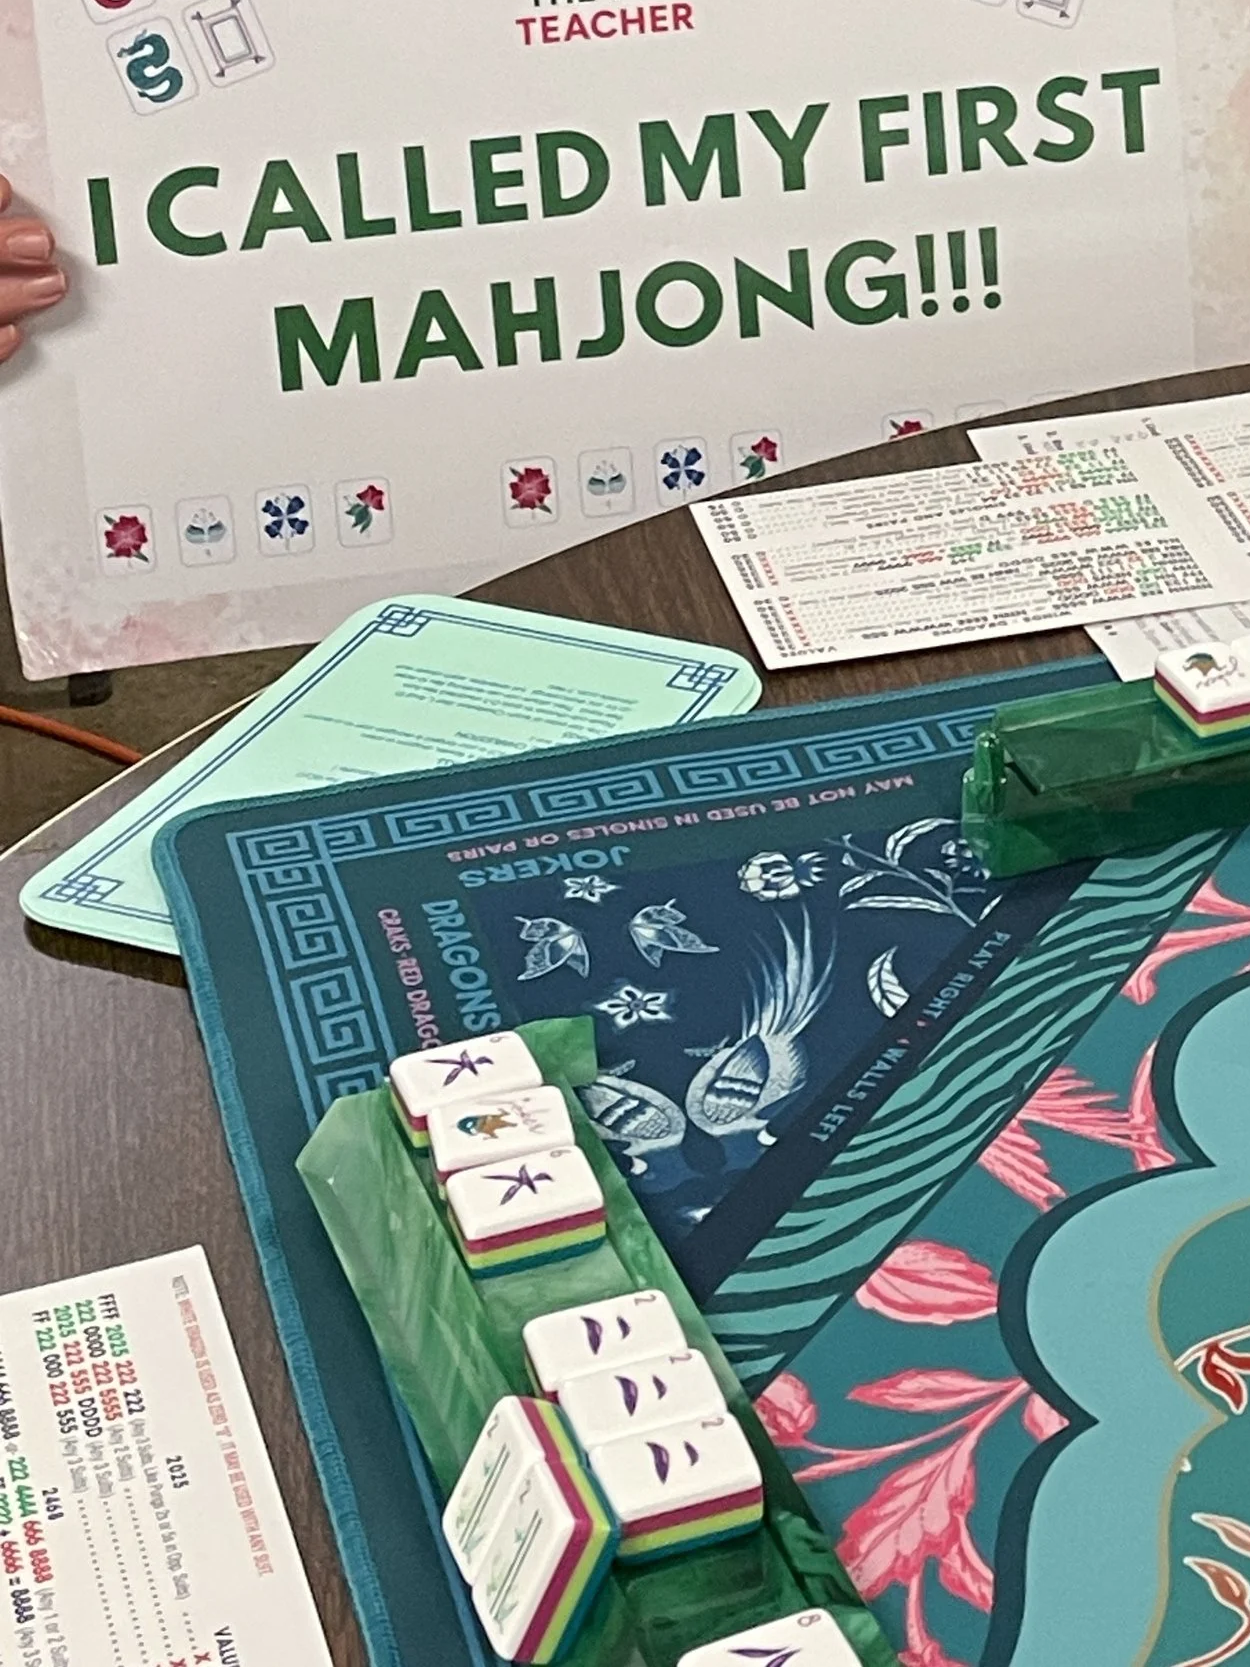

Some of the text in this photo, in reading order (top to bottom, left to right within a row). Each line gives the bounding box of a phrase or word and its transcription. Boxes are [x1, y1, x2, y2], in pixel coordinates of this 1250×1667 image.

[515, 3, 694, 46] TEACHER
[86, 68, 1160, 266] I CALLED MY FIRST
[273, 227, 998, 394] MAHJONG!!!
[446, 774, 915, 863] MAY NOT BE USED IN SINGLES OR PAIRS
[459, 844, 632, 889] JOKERS
[424, 899, 500, 1032] DRAGONS
[927, 929, 1012, 1022] PLAY RIGHT
[810, 1047, 912, 1143] WALLS LEFT
[30, 1309, 51, 1325] FF
[52, 1304, 78, 1338] 2025
[73, 1299, 96, 1325] 222
[97, 1292, 120, 1321] FFFF
[34, 1326, 57, 1352] 222
[61, 1339, 84, 1366] 222
[104, 1323, 129, 1358] 2025
[69, 1367, 92, 1395] 555
[91, 1359, 113, 1386] 222
[114, 1359, 137, 1386] 222
[48, 1379, 71, 1406] 222
[98, 1386, 123, 1422] 5555
[122, 1388, 145, 1415] 222
[55, 1407, 78, 1435] 555
[6, 1455, 30, 1483] 222
[164, 1453, 189, 1490] 2025
[13, 1482, 39, 1518] 4444
[41, 1486, 64, 1521] 2468
[21, 1517, 46, 1546] 666
[0, 1538, 25, 1574] 6666
[27, 1547, 54, 1584] 8888
[9, 1587, 36, 1624] 8888
